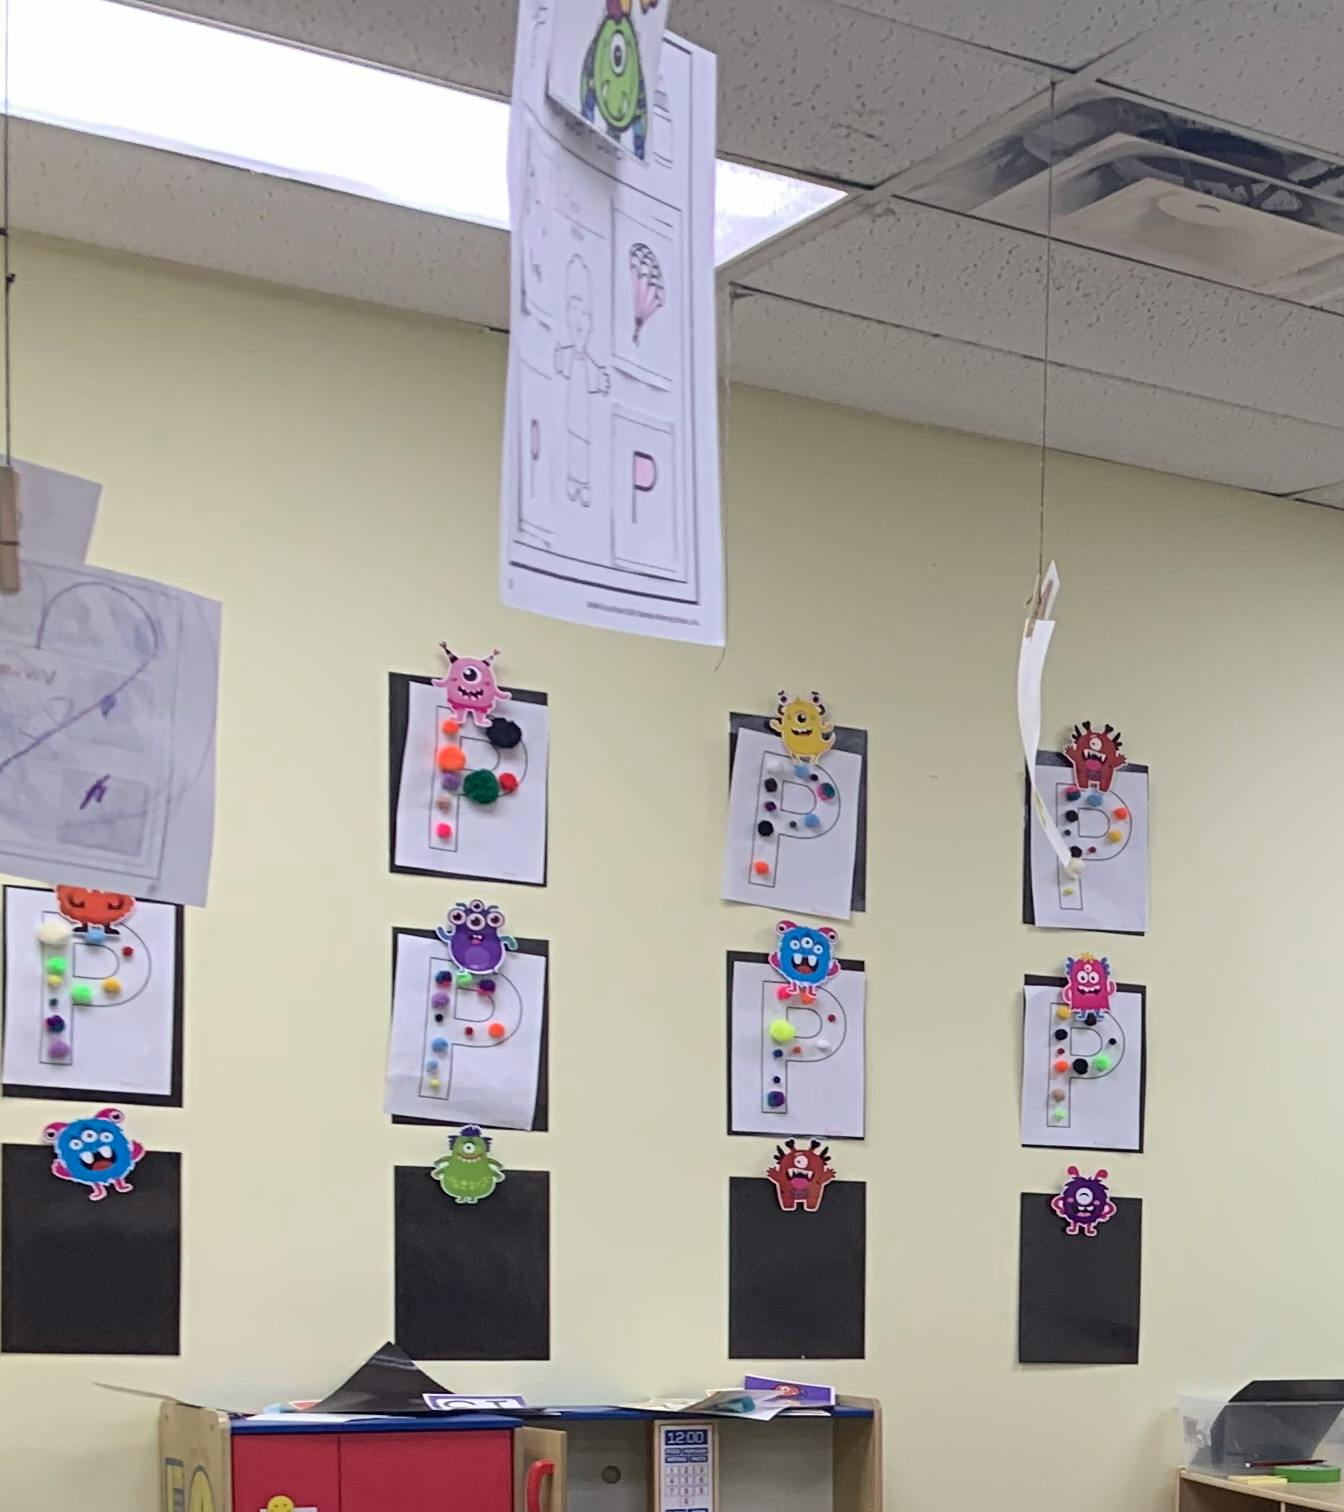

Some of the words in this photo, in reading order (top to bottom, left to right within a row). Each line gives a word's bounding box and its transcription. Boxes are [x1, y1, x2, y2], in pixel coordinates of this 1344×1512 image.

[632, 450, 658, 524] P
[749, 751, 841, 887] P
[419, 957, 523, 1100] P
[762, 980, 848, 1114] P
